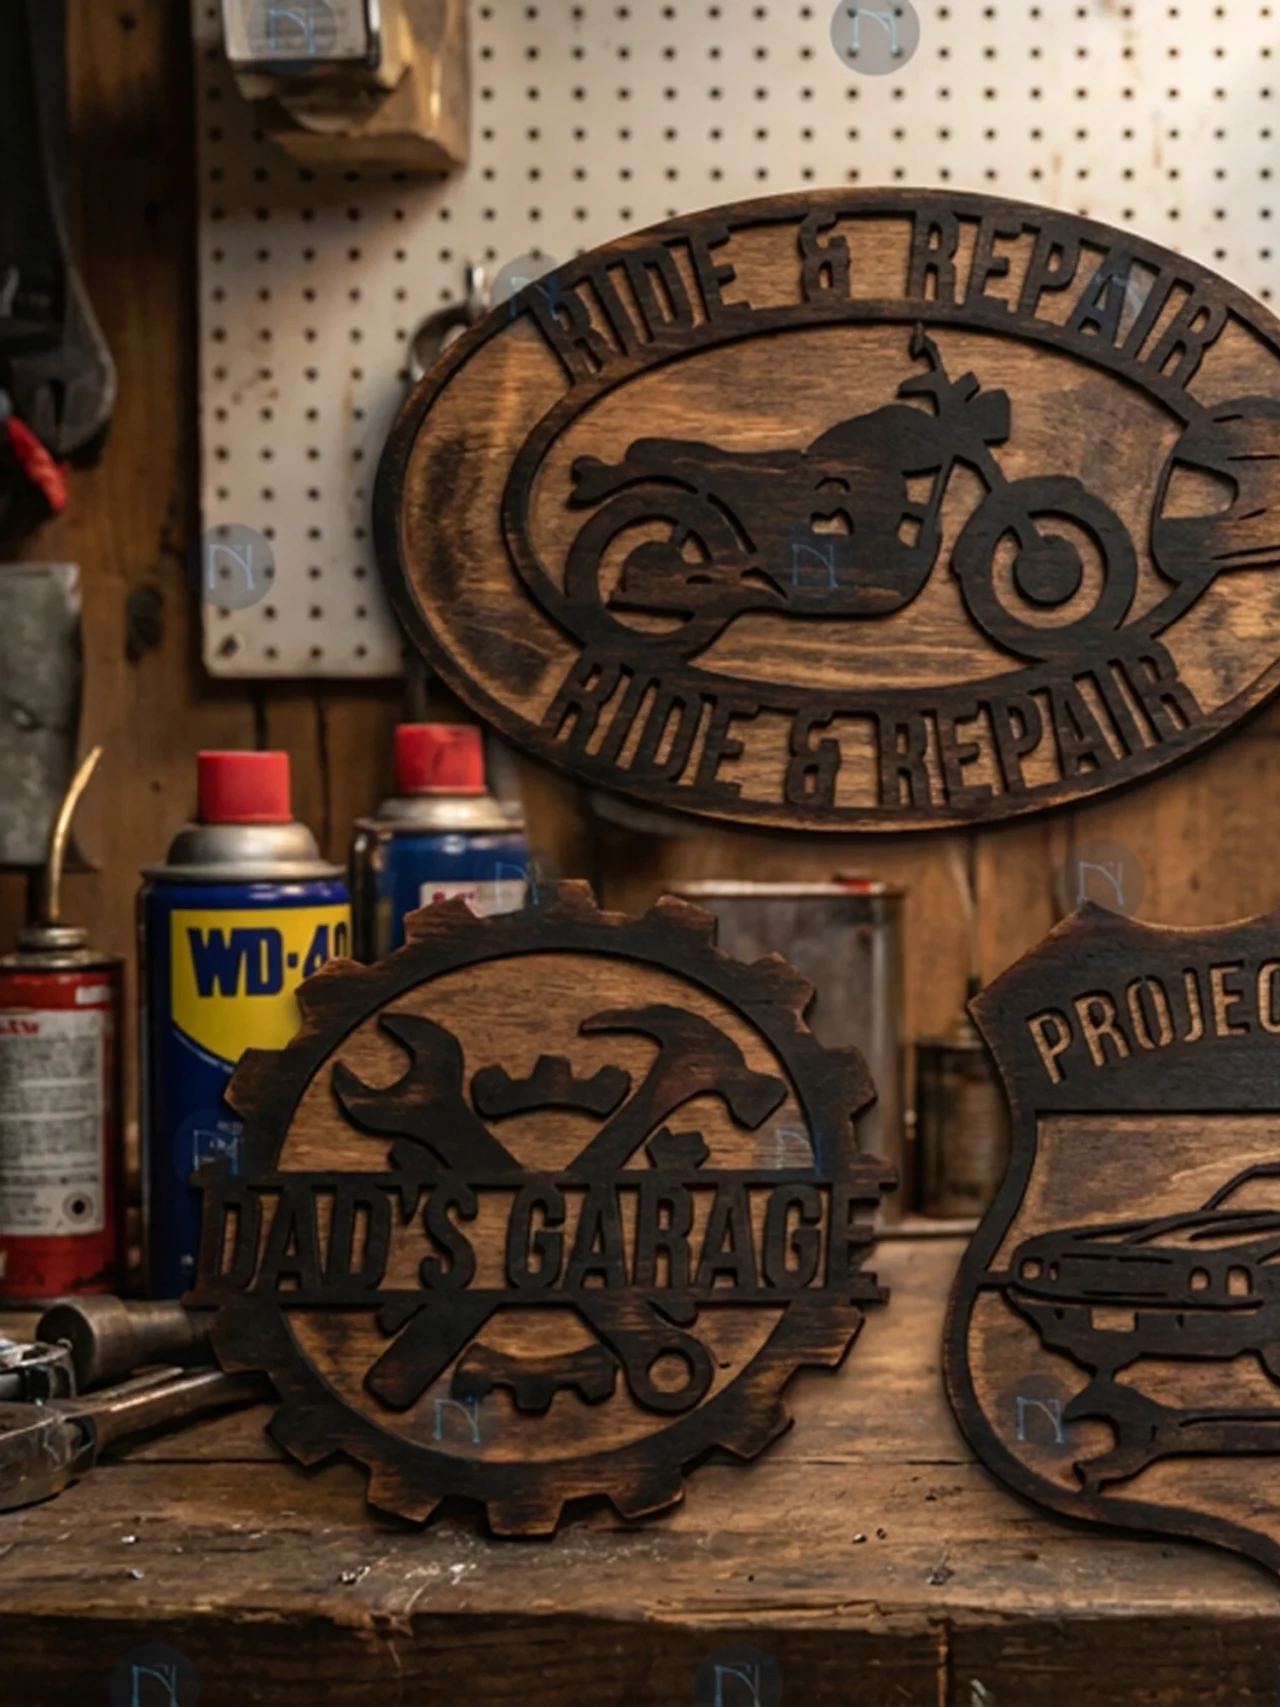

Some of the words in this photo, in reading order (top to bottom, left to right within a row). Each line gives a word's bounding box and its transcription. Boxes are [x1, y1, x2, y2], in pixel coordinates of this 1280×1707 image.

[532, 222, 752, 388] RIDE
[798, 208, 851, 304] &
[904, 210, 1230, 392] REPAIR
[545, 650, 758, 804] RIDE
[877, 643, 1202, 812] REPAIR
[205, 1182, 480, 1296] DAD'S
[506, 1182, 890, 1300] GARAGE
